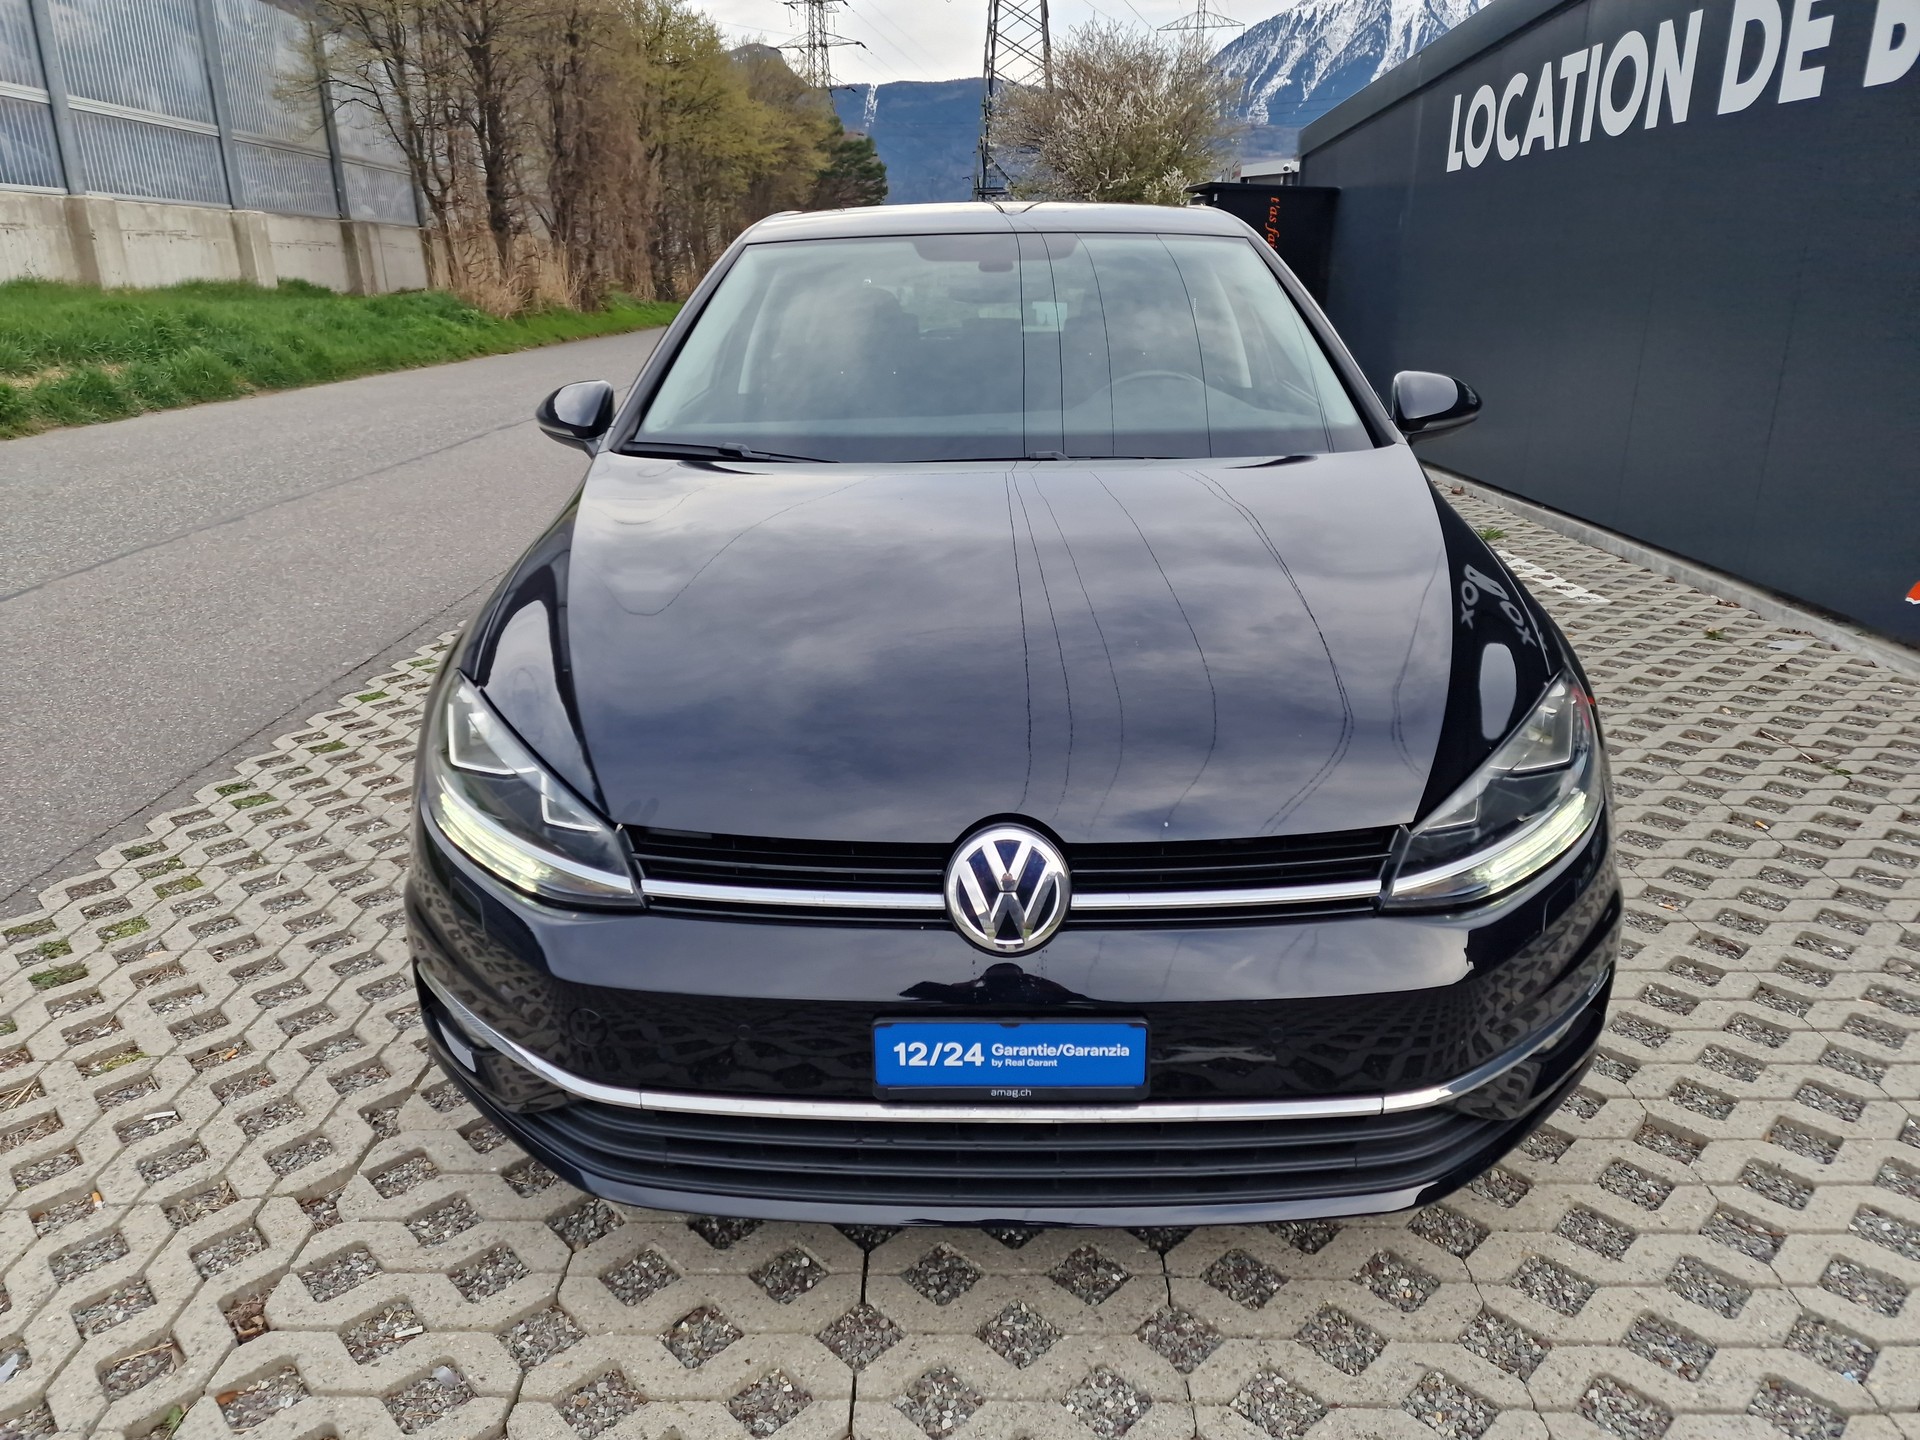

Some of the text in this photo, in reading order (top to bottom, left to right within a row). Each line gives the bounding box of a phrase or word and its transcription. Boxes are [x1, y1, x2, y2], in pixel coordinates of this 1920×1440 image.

[1446, 8, 1704, 173] LOCATION
[1717, 0, 1835, 116] DE
[893, 1042, 985, 1067] 12/24
[991, 1043, 1130, 1057] Garantie/Garanzia
[991, 1058, 1058, 1067] by Real Garant
[990, 1088, 1032, 1098] amag.ch
